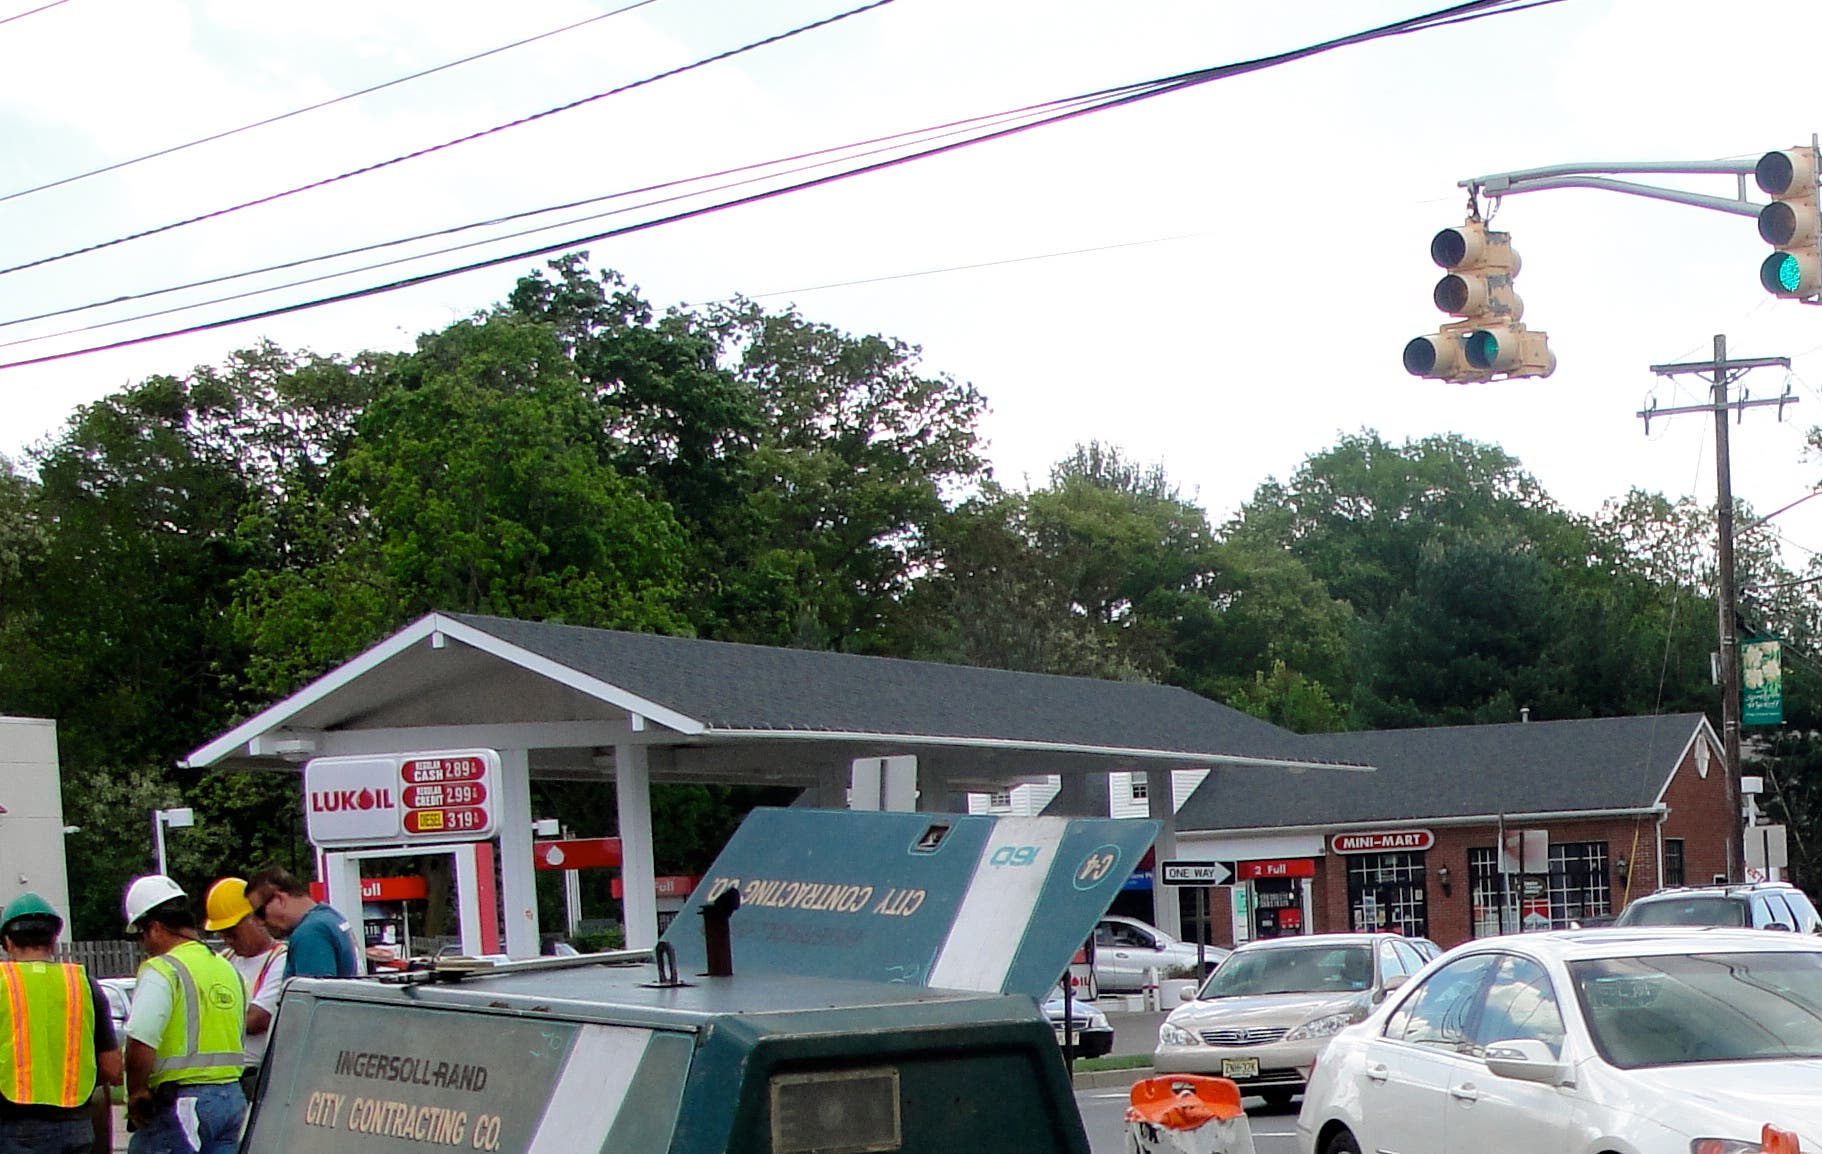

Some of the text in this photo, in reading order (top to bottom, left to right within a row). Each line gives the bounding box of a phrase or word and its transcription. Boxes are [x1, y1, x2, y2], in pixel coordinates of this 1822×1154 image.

[413, 769, 444, 783] CASH
[312, 787, 395, 812] LUKOIL
[415, 794, 445, 808] CREDIT
[419, 812, 443, 828] DIESEL
[1342, 834, 1421, 849] MINI-MART
[1169, 867, 1215, 878] ONE WAY
[1254, 864, 1287, 875] 2 Full
[741, 879, 873, 914] CONTRACTING
[873, 887, 927, 917] CITY
[334, 1049, 488, 1093] INGERSOLL-RAND
[305, 1090, 502, 1152] CITY CONTRACTING CO.
